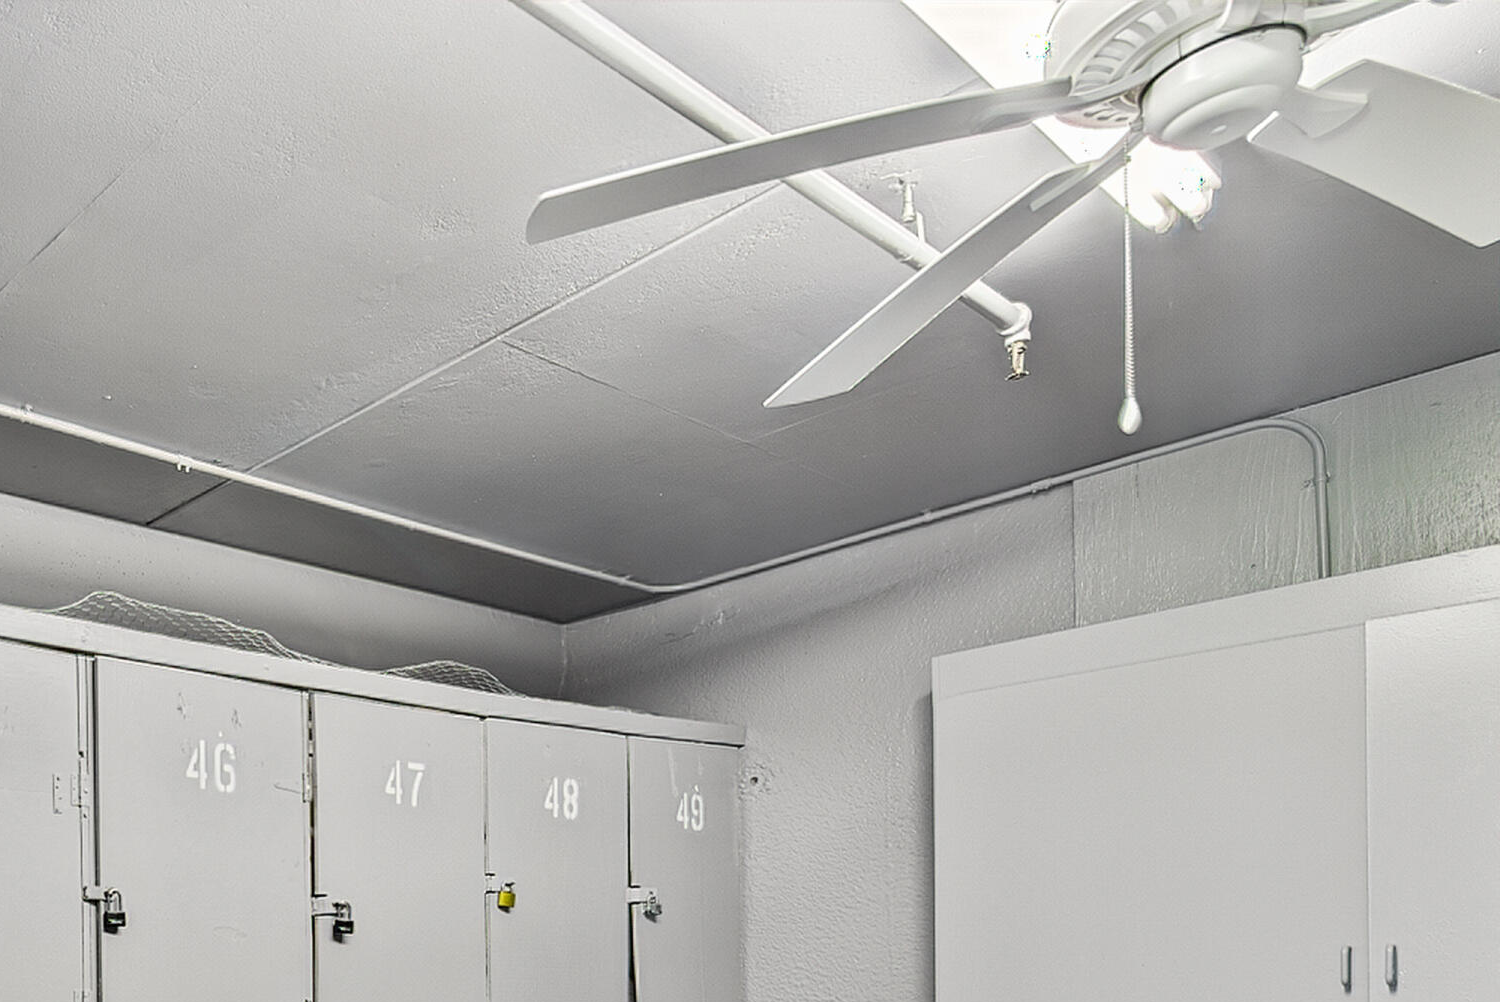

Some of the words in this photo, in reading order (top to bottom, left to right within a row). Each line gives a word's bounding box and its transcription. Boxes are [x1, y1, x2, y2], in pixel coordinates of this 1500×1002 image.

[186, 738, 237, 794] 46
[384, 759, 426, 807] 47
[543, 776, 580, 820] 48
[676, 790, 704, 832] 49
